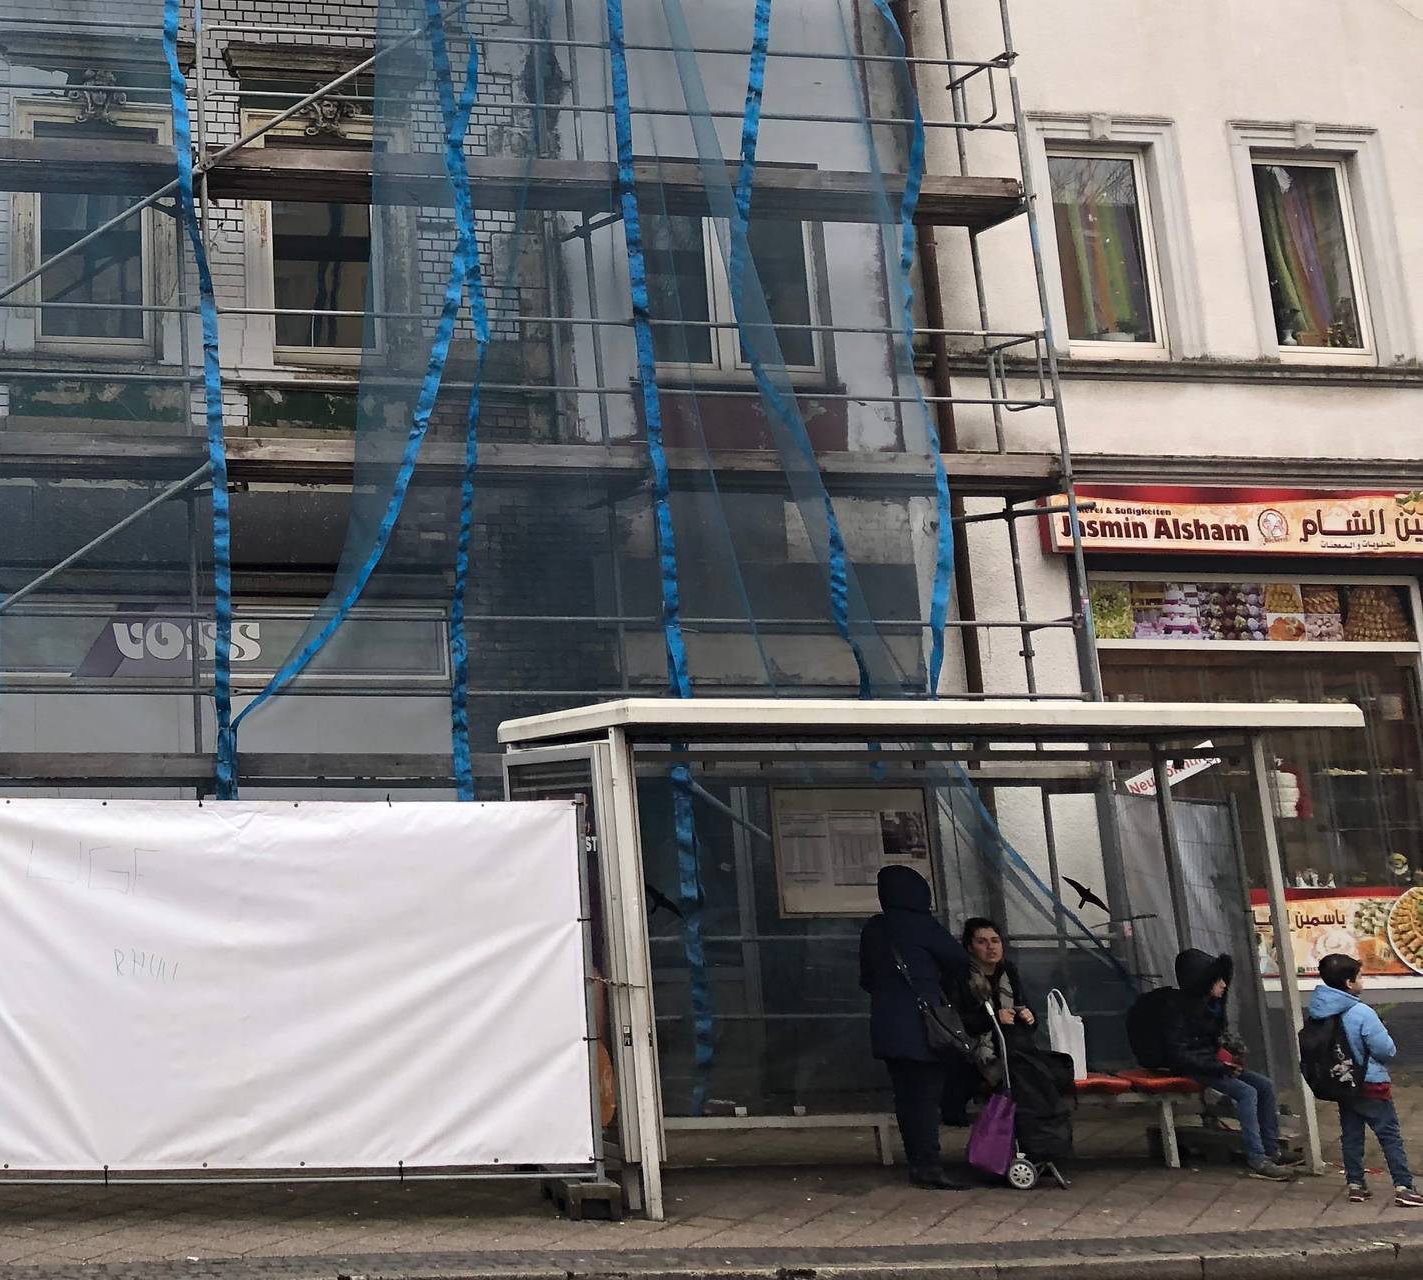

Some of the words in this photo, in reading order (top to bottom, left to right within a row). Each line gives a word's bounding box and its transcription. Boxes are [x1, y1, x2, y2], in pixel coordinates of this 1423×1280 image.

[1153, 517, 1250, 542] Alsham
[1299, 508, 1385, 542] الشام
[112, 621, 262, 661] VOSS
[585, 836, 597, 852] ST
[1295, 908, 1347, 929] ياسمين
